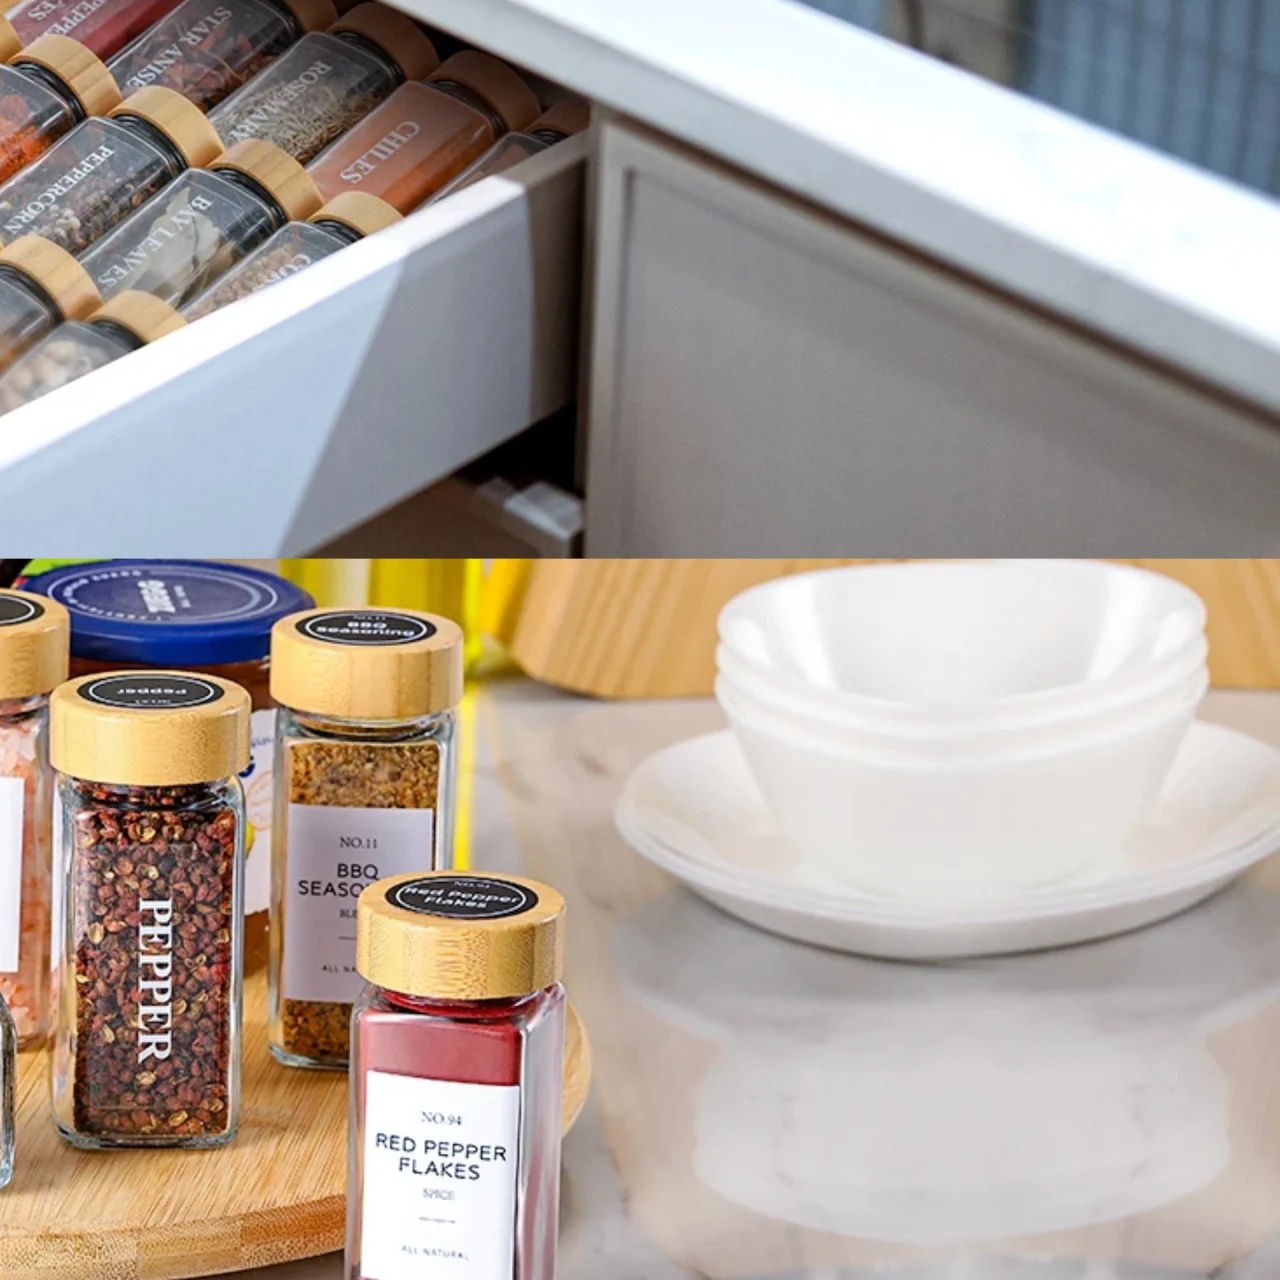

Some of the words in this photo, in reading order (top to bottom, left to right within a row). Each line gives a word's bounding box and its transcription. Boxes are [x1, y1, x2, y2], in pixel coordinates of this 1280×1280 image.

[179, 5, 233, 47] STAR
[126, 43, 184, 88] ANISE
[339, 120, 421, 185] CHILES
[3, 145, 115, 235] PEPPERCORN
[172, 194, 214, 229] BAY
[97, 224, 176, 288] LEAVES
[316, 626, 416, 638] Seasoning
[339, 836, 378, 849] NO.11
[336, 862, 380, 881] BBQ
[405, 886, 444, 896] Red
[447, 889, 522, 904] Pepper
[423, 896, 488, 909] Flakes
[137, 898, 173, 1065] PEPPER
[421, 1110, 462, 1126] NO.94
[375, 1132, 417, 1153] RED
[424, 1139, 507, 1162] PEPPER
[398, 1156, 481, 1181] FLAKES
[422, 1188, 455, 1201] SPICE
[401, 1245, 418, 1255] ALL
[422, 1247, 470, 1261] NATURAL
